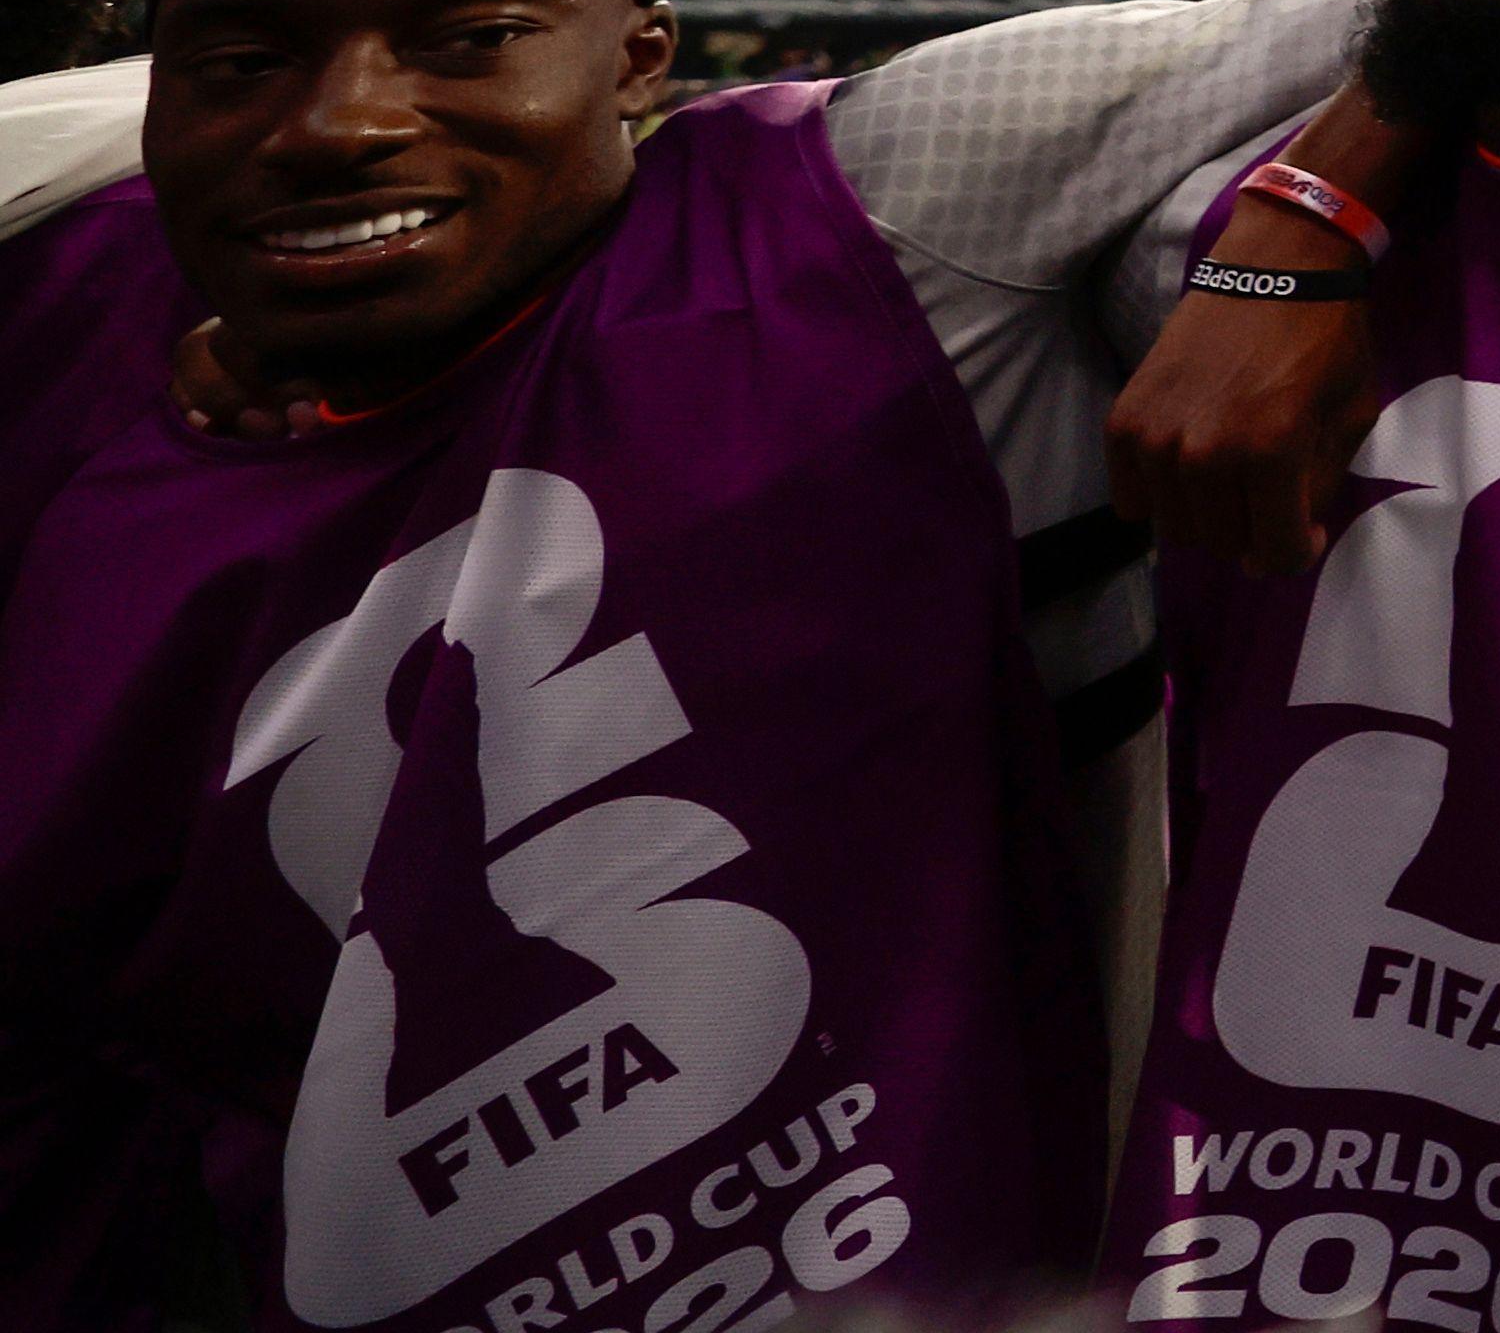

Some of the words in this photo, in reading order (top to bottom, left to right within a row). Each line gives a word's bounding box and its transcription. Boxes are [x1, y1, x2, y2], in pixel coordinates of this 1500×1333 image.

[398, 1022, 680, 1218] FIFA
[690, 1083, 877, 1230] CUP
[1172, 1128, 1462, 1201] WORLD
